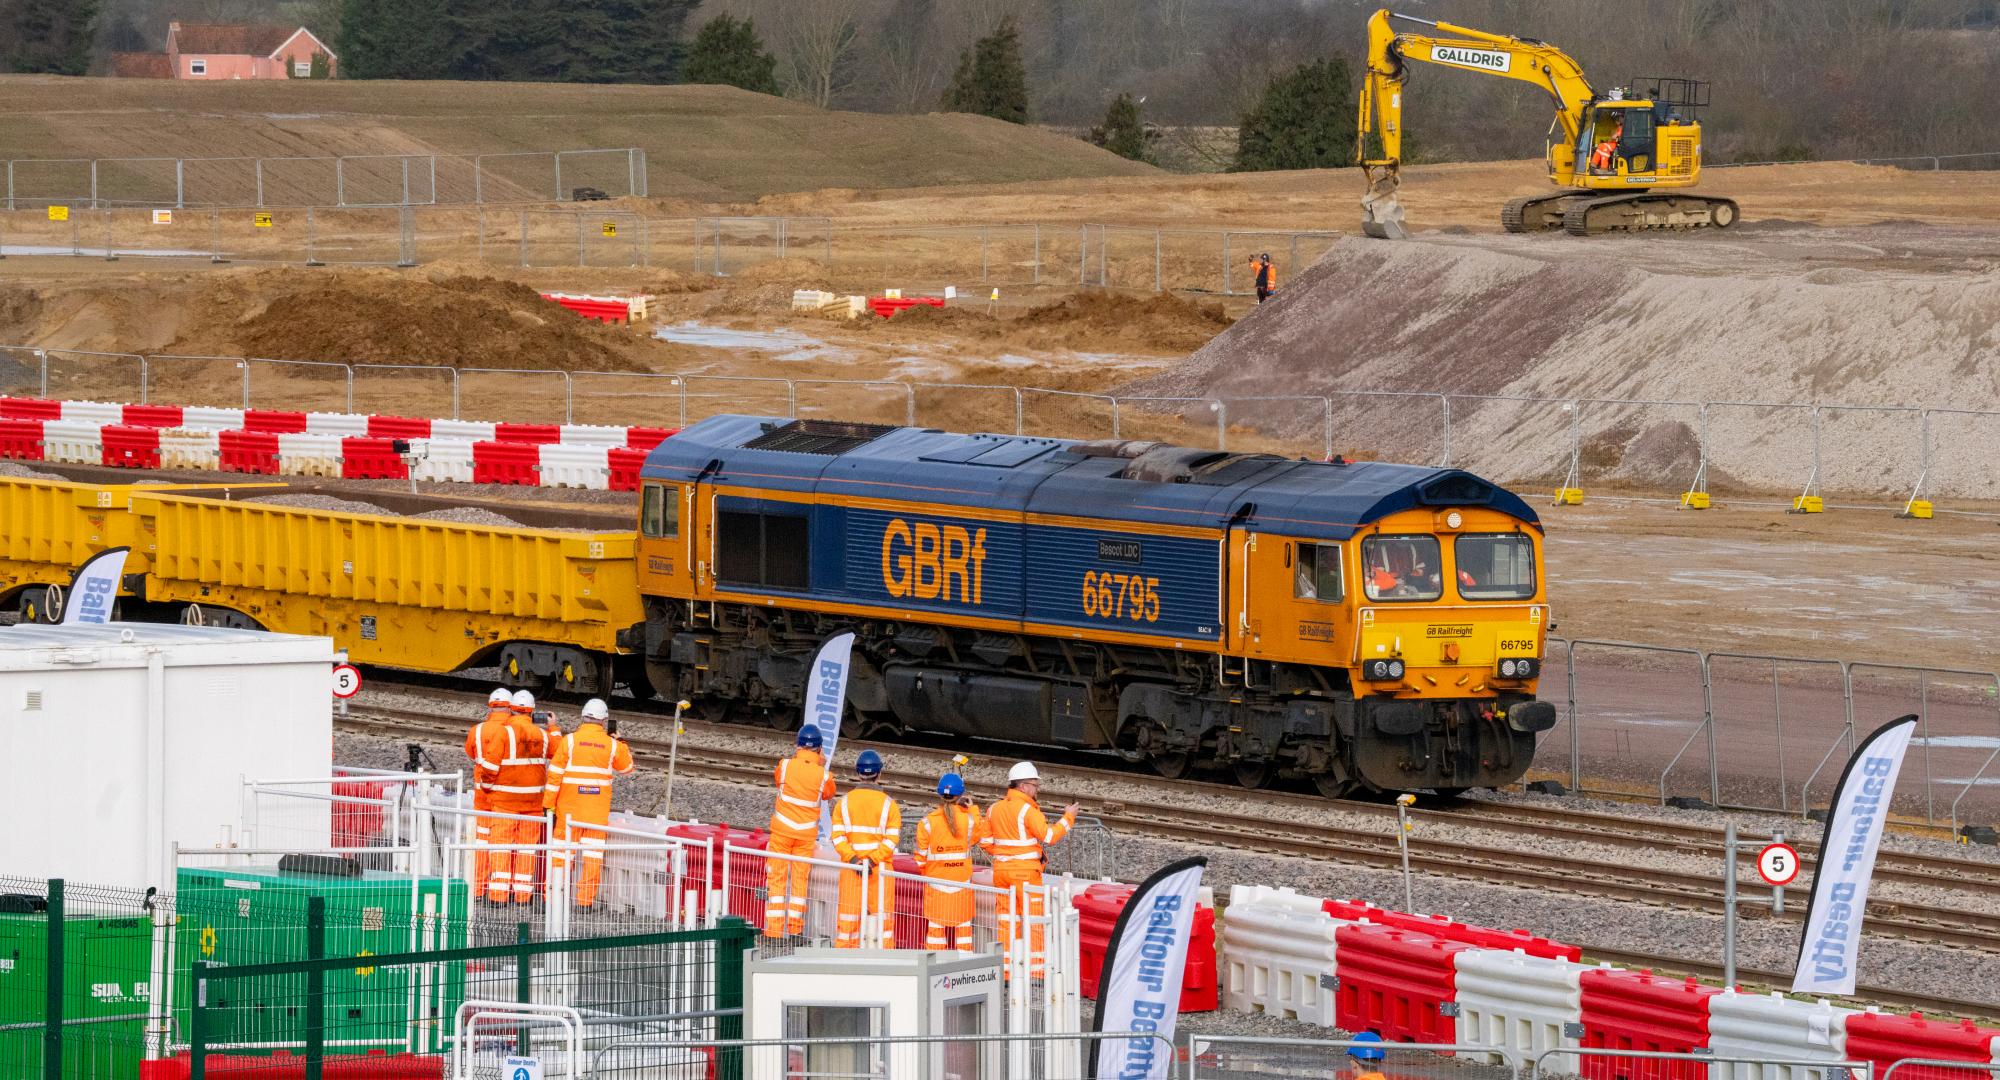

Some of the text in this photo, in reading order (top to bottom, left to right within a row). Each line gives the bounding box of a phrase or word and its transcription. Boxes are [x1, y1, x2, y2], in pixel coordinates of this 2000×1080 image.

[1437, 48, 1505, 67] GALLDRIS
[1100, 542, 1139, 558] Bescot LDC
[882, 518, 987, 605] GBRf
[79, 577, 112, 624] Balf
[1082, 570, 1160, 622] 66795
[1426, 627, 1473, 637] GB Railfreight
[1500, 640, 1534, 650] 66795
[340, 674, 349, 688] 5
[1772, 855, 1785, 872] 5
[1137, 895, 1182, 993] Balfour
[951, 969, 997, 989] pwhire.co.uk
